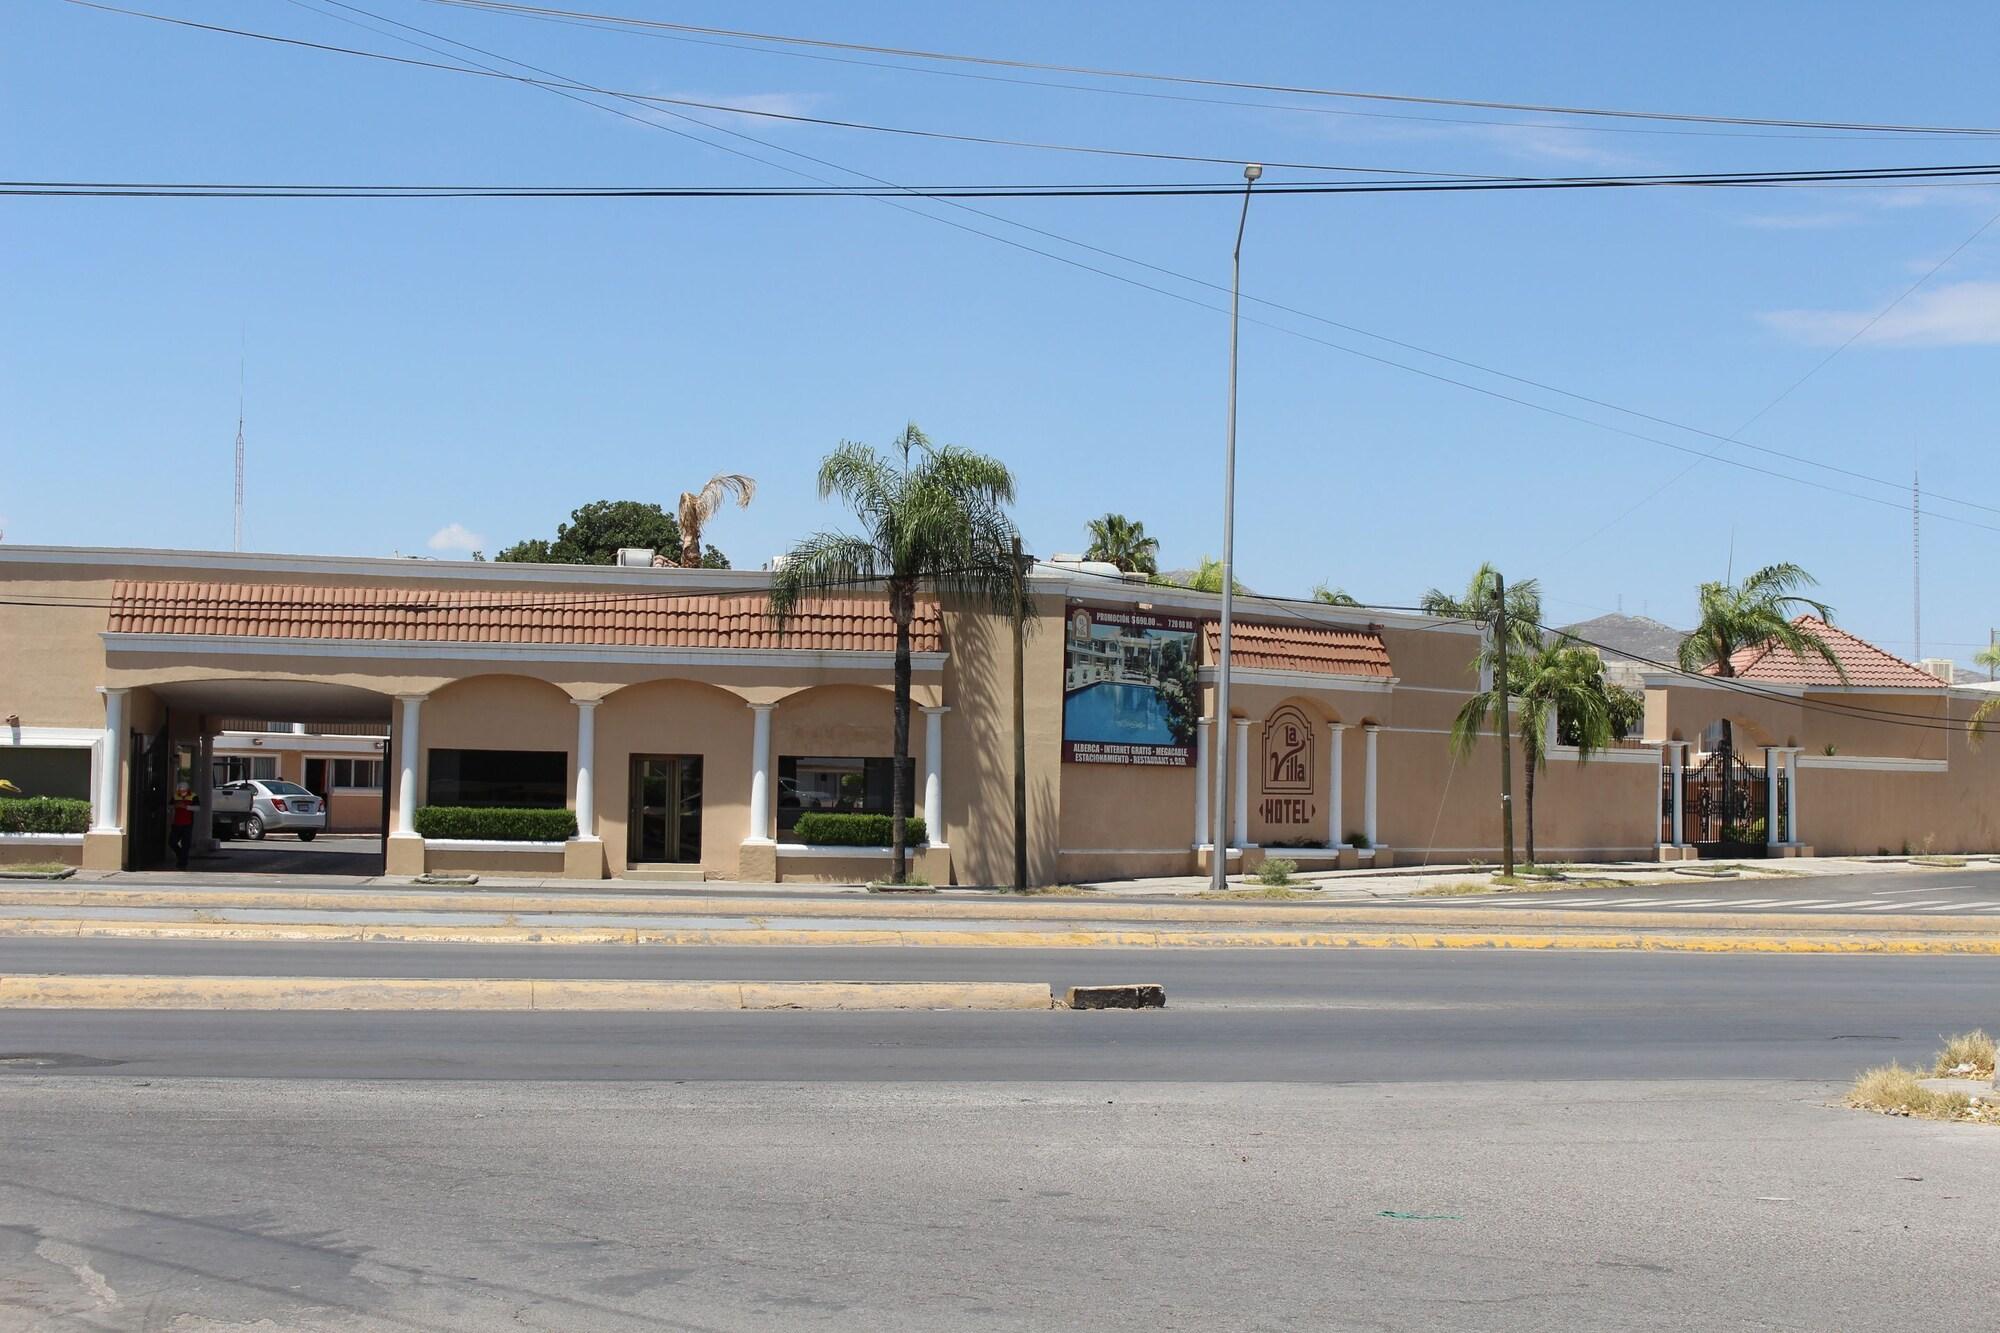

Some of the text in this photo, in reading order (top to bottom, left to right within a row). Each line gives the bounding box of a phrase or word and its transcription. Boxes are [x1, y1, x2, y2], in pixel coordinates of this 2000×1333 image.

[1096, 612, 1130, 624] PROMOCIÓN
[1285, 725, 1299, 746] La
[1073, 743, 1100, 753] ALBERCA
[1104, 744, 1131, 754] INTERNET
[1131, 746, 1152, 755] GRATIS
[1075, 753, 1130, 764] ESTACIONAMIENTO
[1133, 755, 1169, 765] RESTAURANT
[1271, 739, 1306, 782] Villa
[1265, 799, 1310, 824] HOTEL
